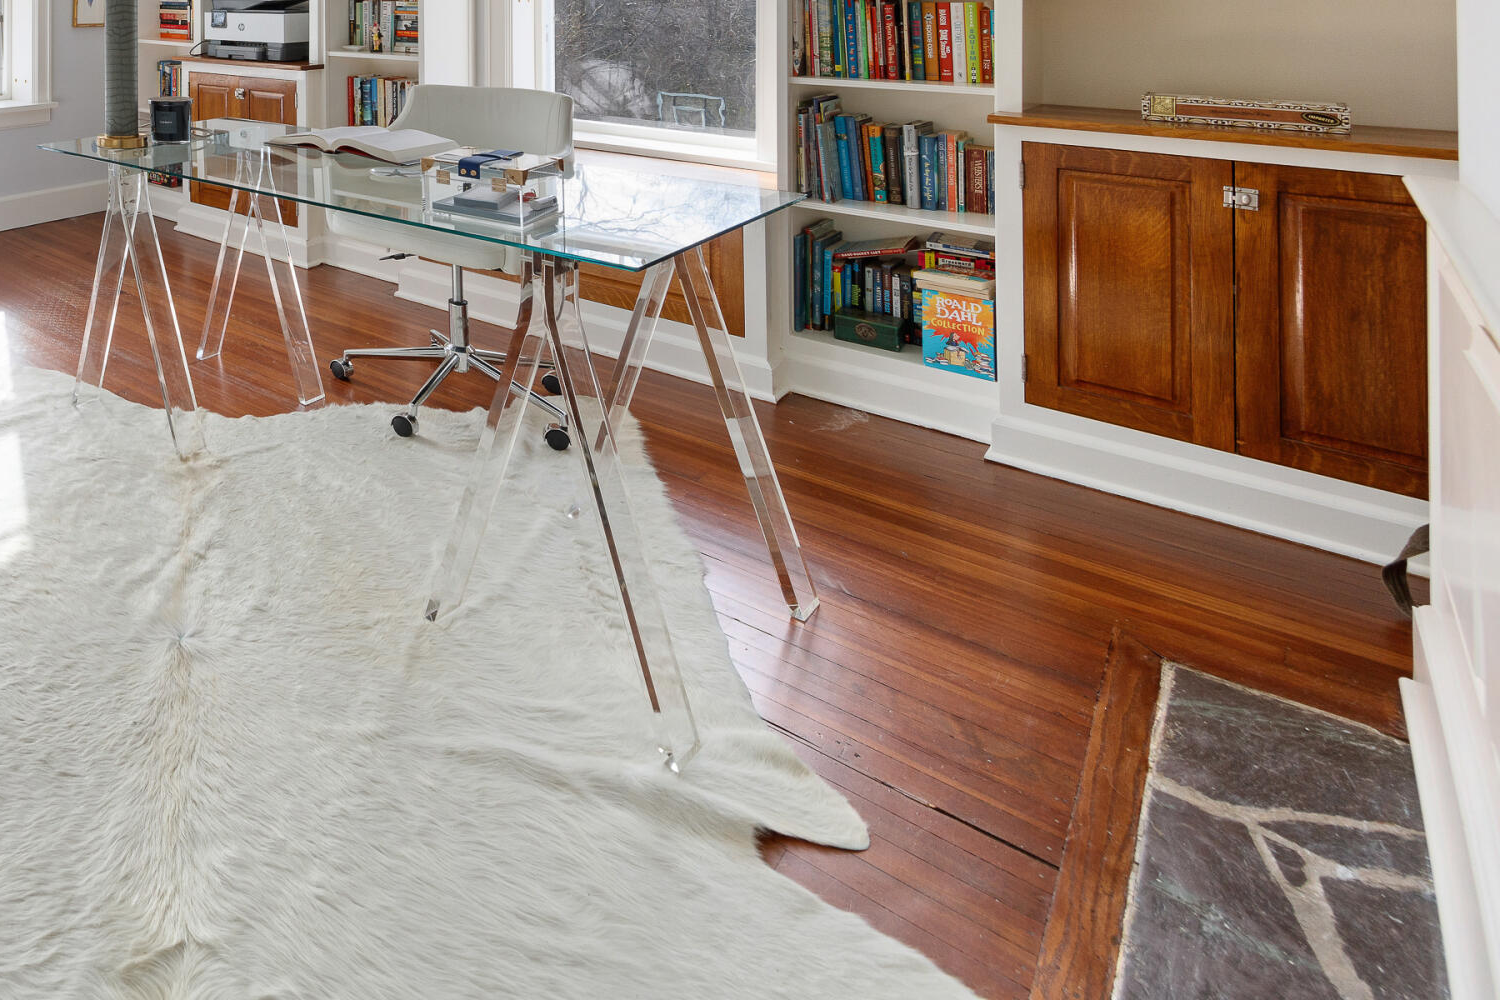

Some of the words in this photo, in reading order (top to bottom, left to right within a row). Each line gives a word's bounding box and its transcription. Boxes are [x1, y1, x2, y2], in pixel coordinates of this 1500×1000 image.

[936, 296, 982, 314] ROALD
[936, 306, 982, 326] DAHL
[931, 317, 985, 336] COLLECTION
